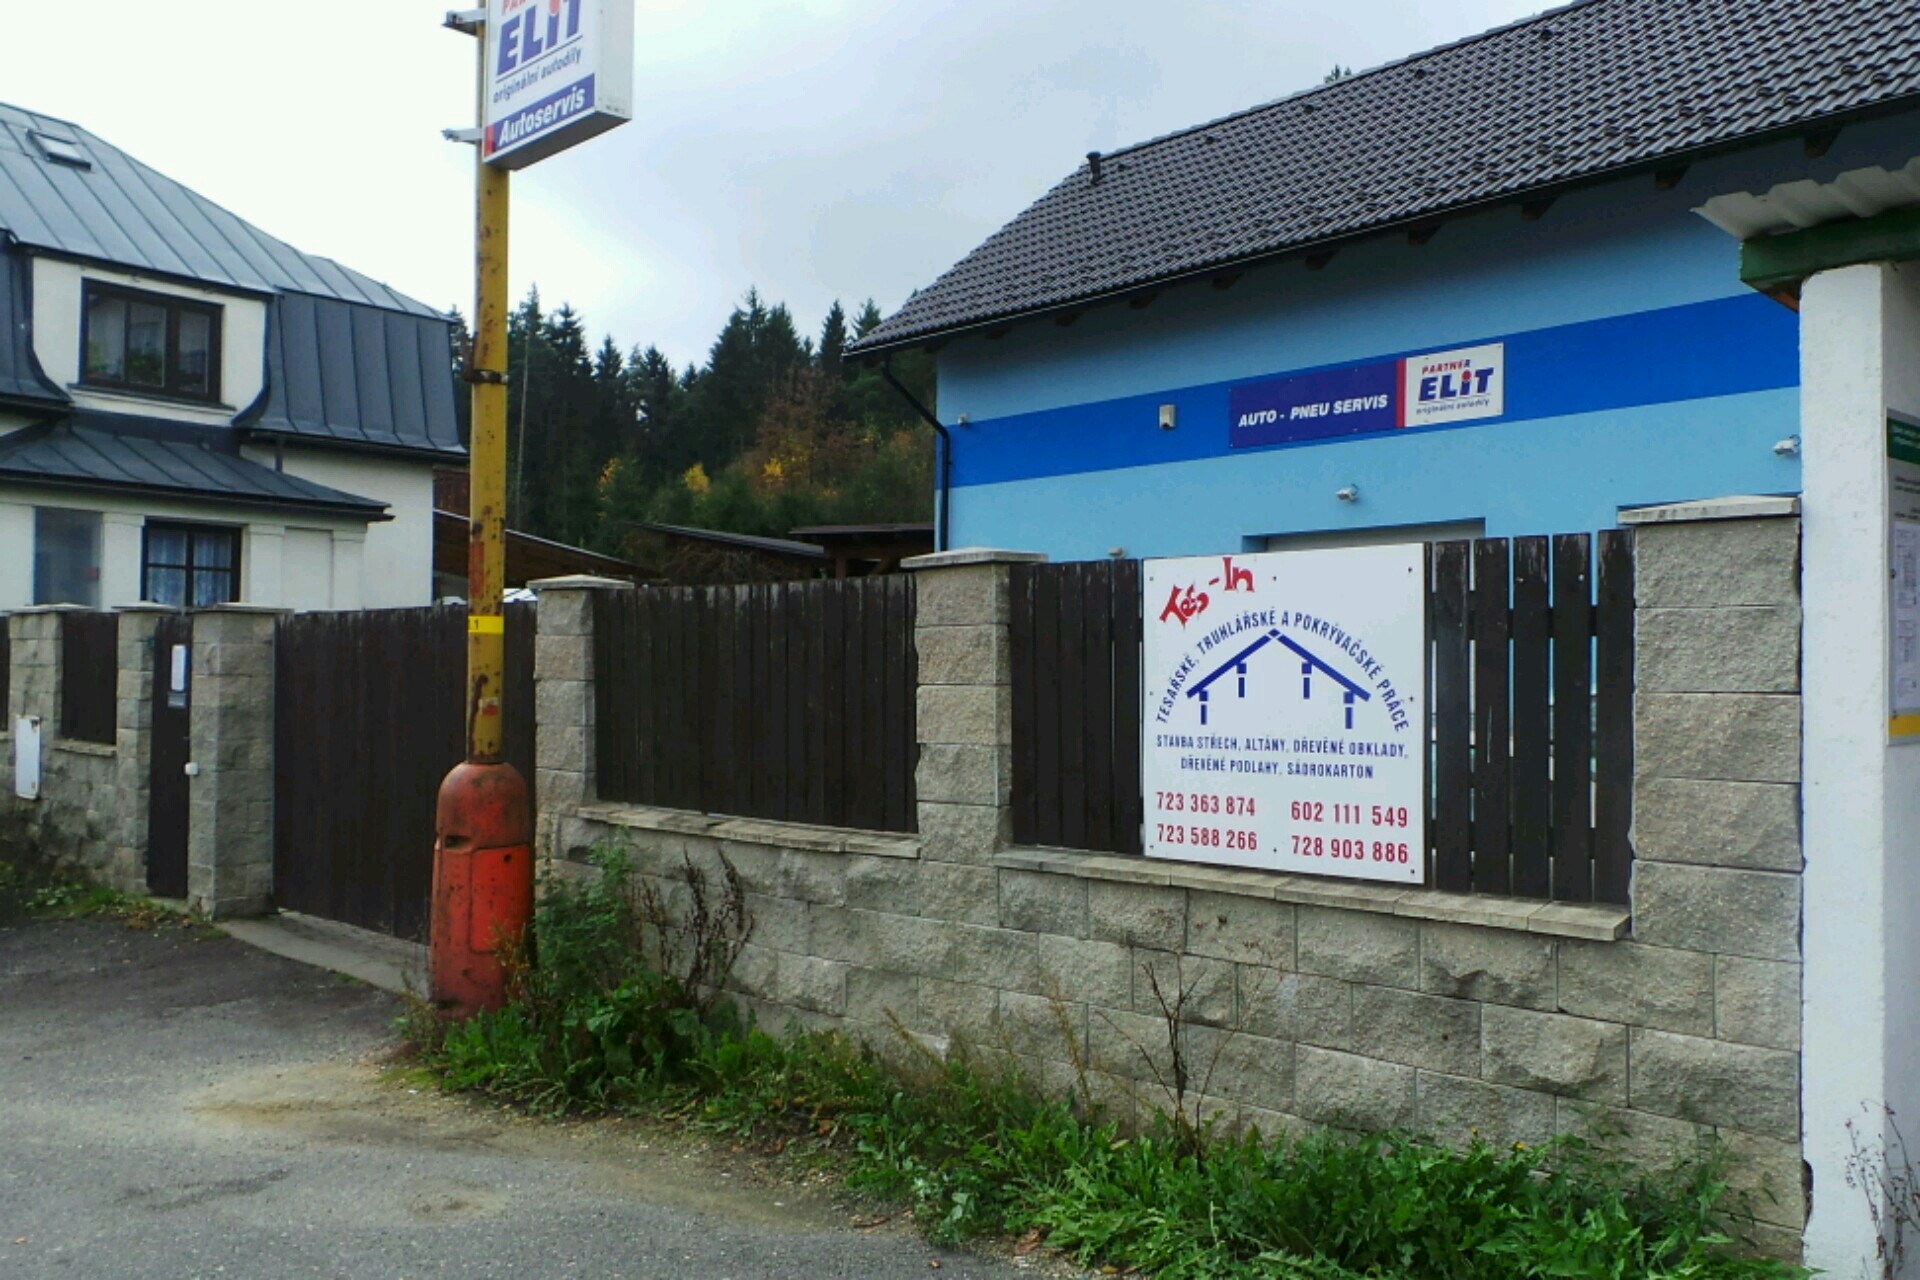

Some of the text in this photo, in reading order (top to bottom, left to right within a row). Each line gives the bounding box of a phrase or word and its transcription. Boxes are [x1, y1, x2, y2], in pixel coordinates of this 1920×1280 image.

[498, 86, 585, 147] Autoservis
[1422, 359, 1470, 374] PARTNER
[1238, 410, 1277, 427] AUTO
[1290, 402, 1329, 420] PNEU
[1333, 394, 1388, 414] SERVIS
[1196, 606, 1275, 655] TRUHLÁŘSKÉ
[1281, 610, 1289, 626] A
[1294, 612, 1385, 680] POKRÝVAČSKÉ
[1376, 678, 1409, 732] PRÁCE
[1293, 736, 1344, 755] DŘEVĚNÉ
[1349, 742, 1408, 759] OBKLADY,
[1287, 760, 1374, 779] SÁDROKARTON
[1156, 791, 1256, 817] 723 363 874
[1291, 801, 1408, 828] 602 111 549
[1157, 823, 1258, 850] 723 588 266
[1291, 835, 1408, 864] 728 903 886
